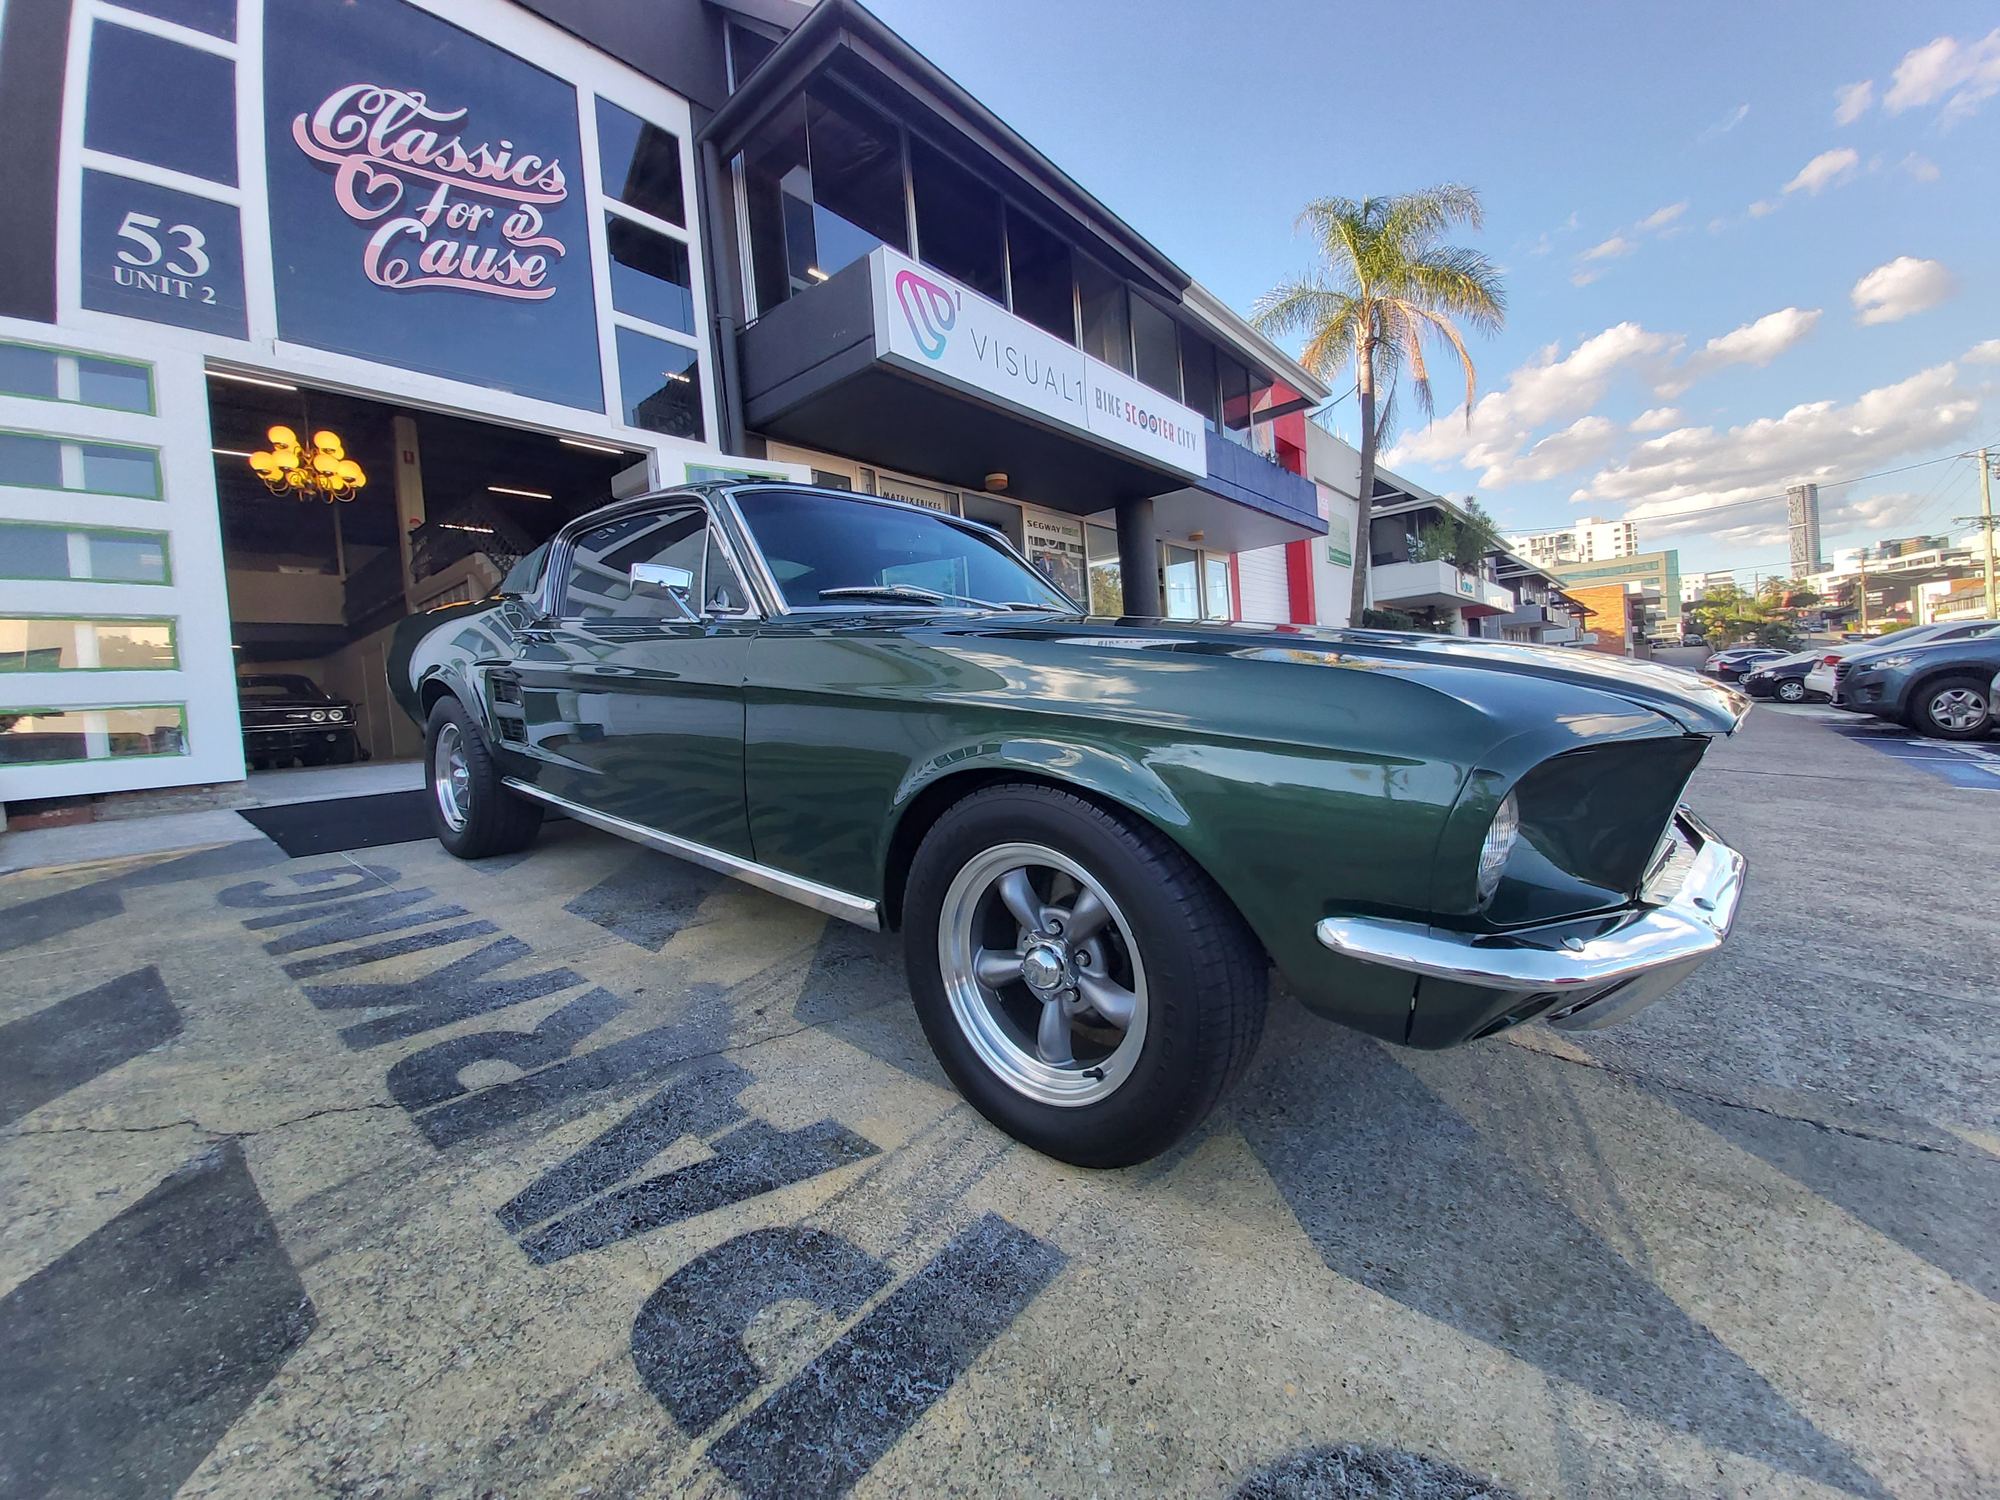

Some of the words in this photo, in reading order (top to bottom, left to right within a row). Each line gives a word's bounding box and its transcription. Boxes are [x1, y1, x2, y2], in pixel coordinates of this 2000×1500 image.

[294, 84, 567, 203] Classics
[117, 211, 210, 278] 53
[364, 217, 557, 299] Cause
[112, 265, 194, 299] UNIT
[201, 286, 217, 305] 2
[970, 328, 1083, 407] VISUAL1
[1095, 387, 1121, 419] BIKE
[1125, 402, 1175, 443] SCOOTER
[1177, 426, 1197, 452] CITY
[1027, 519, 1061, 533] SEGWAY
[217, 864, 1071, 1500] PARKING
